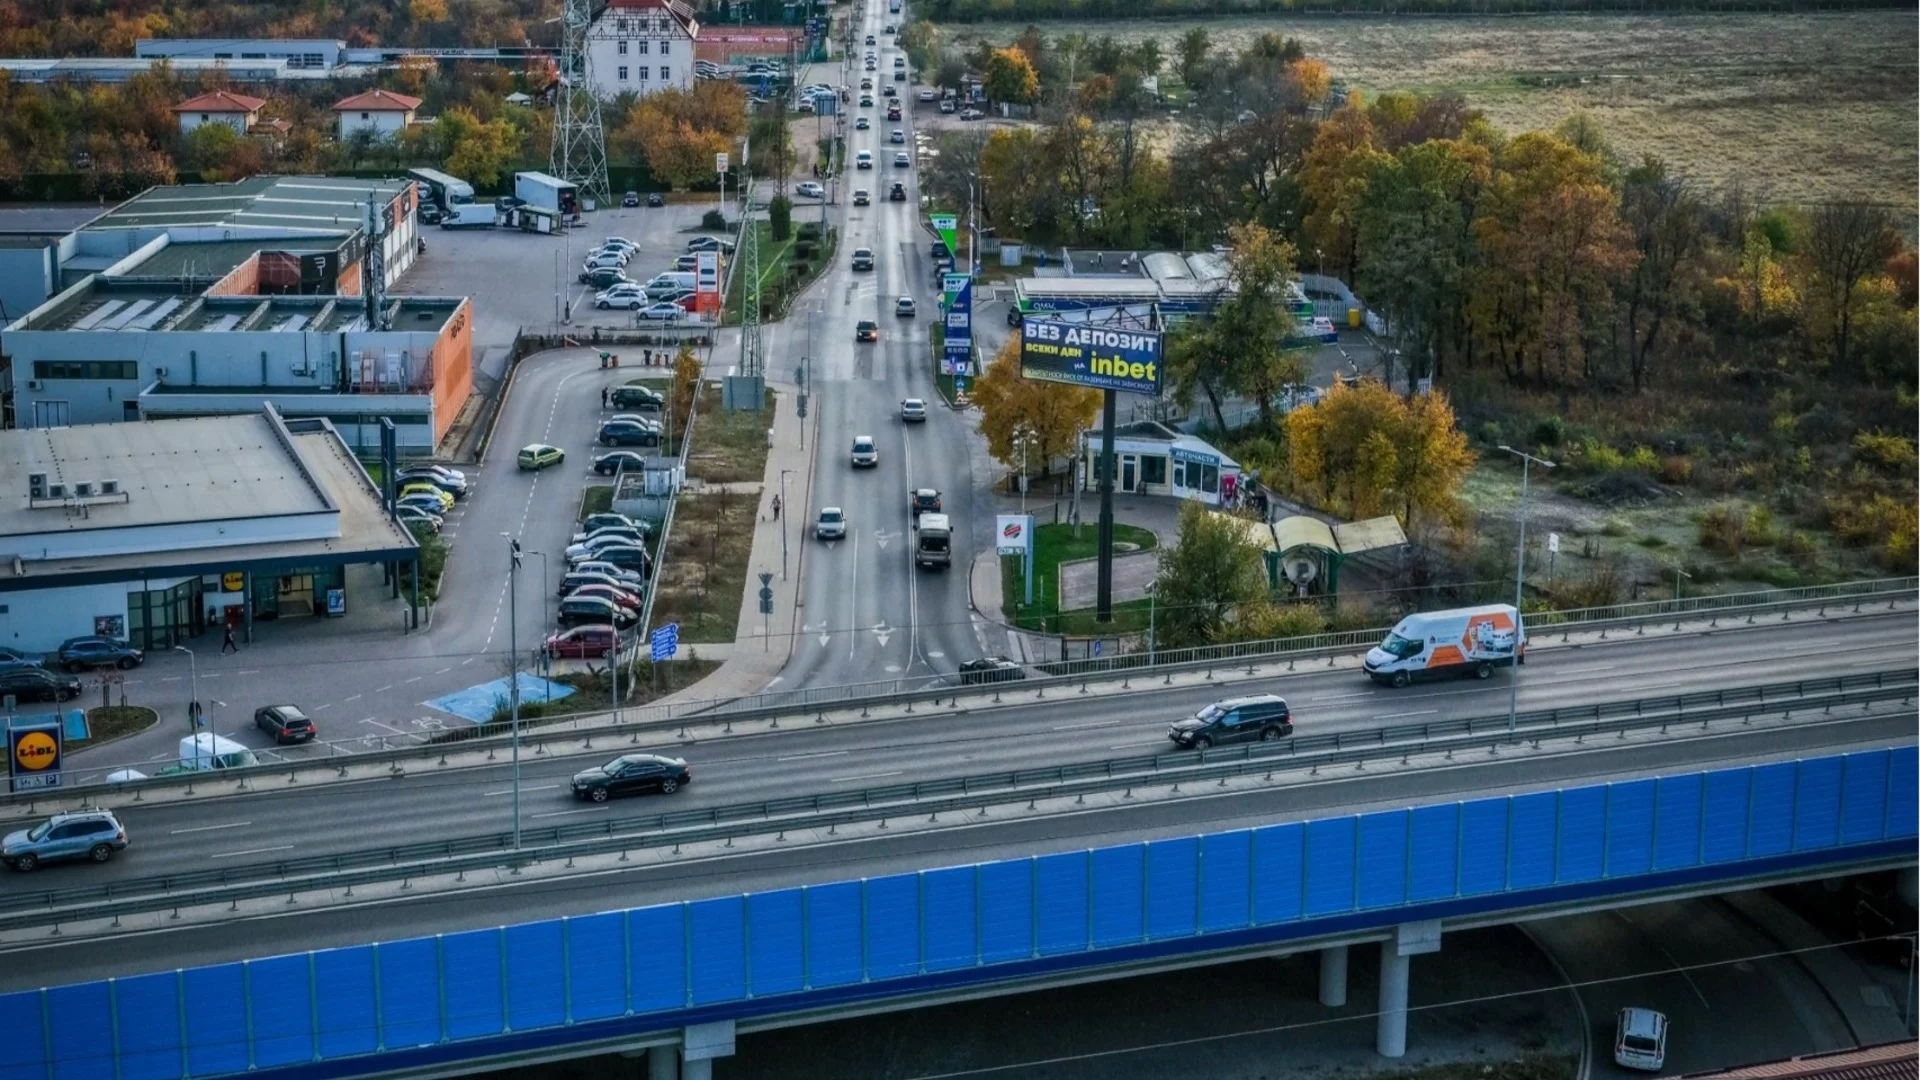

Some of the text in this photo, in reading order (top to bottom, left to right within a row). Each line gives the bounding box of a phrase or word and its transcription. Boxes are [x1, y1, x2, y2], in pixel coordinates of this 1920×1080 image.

[1025, 323, 1157, 352] БЕЗ ДЕПОЗИТ
[1025, 343, 1082, 358] ВСЕКИ ДЕН
[1090, 351, 1156, 381] inbet
[1175, 450, 1215, 463] АВТОЧАСТИ
